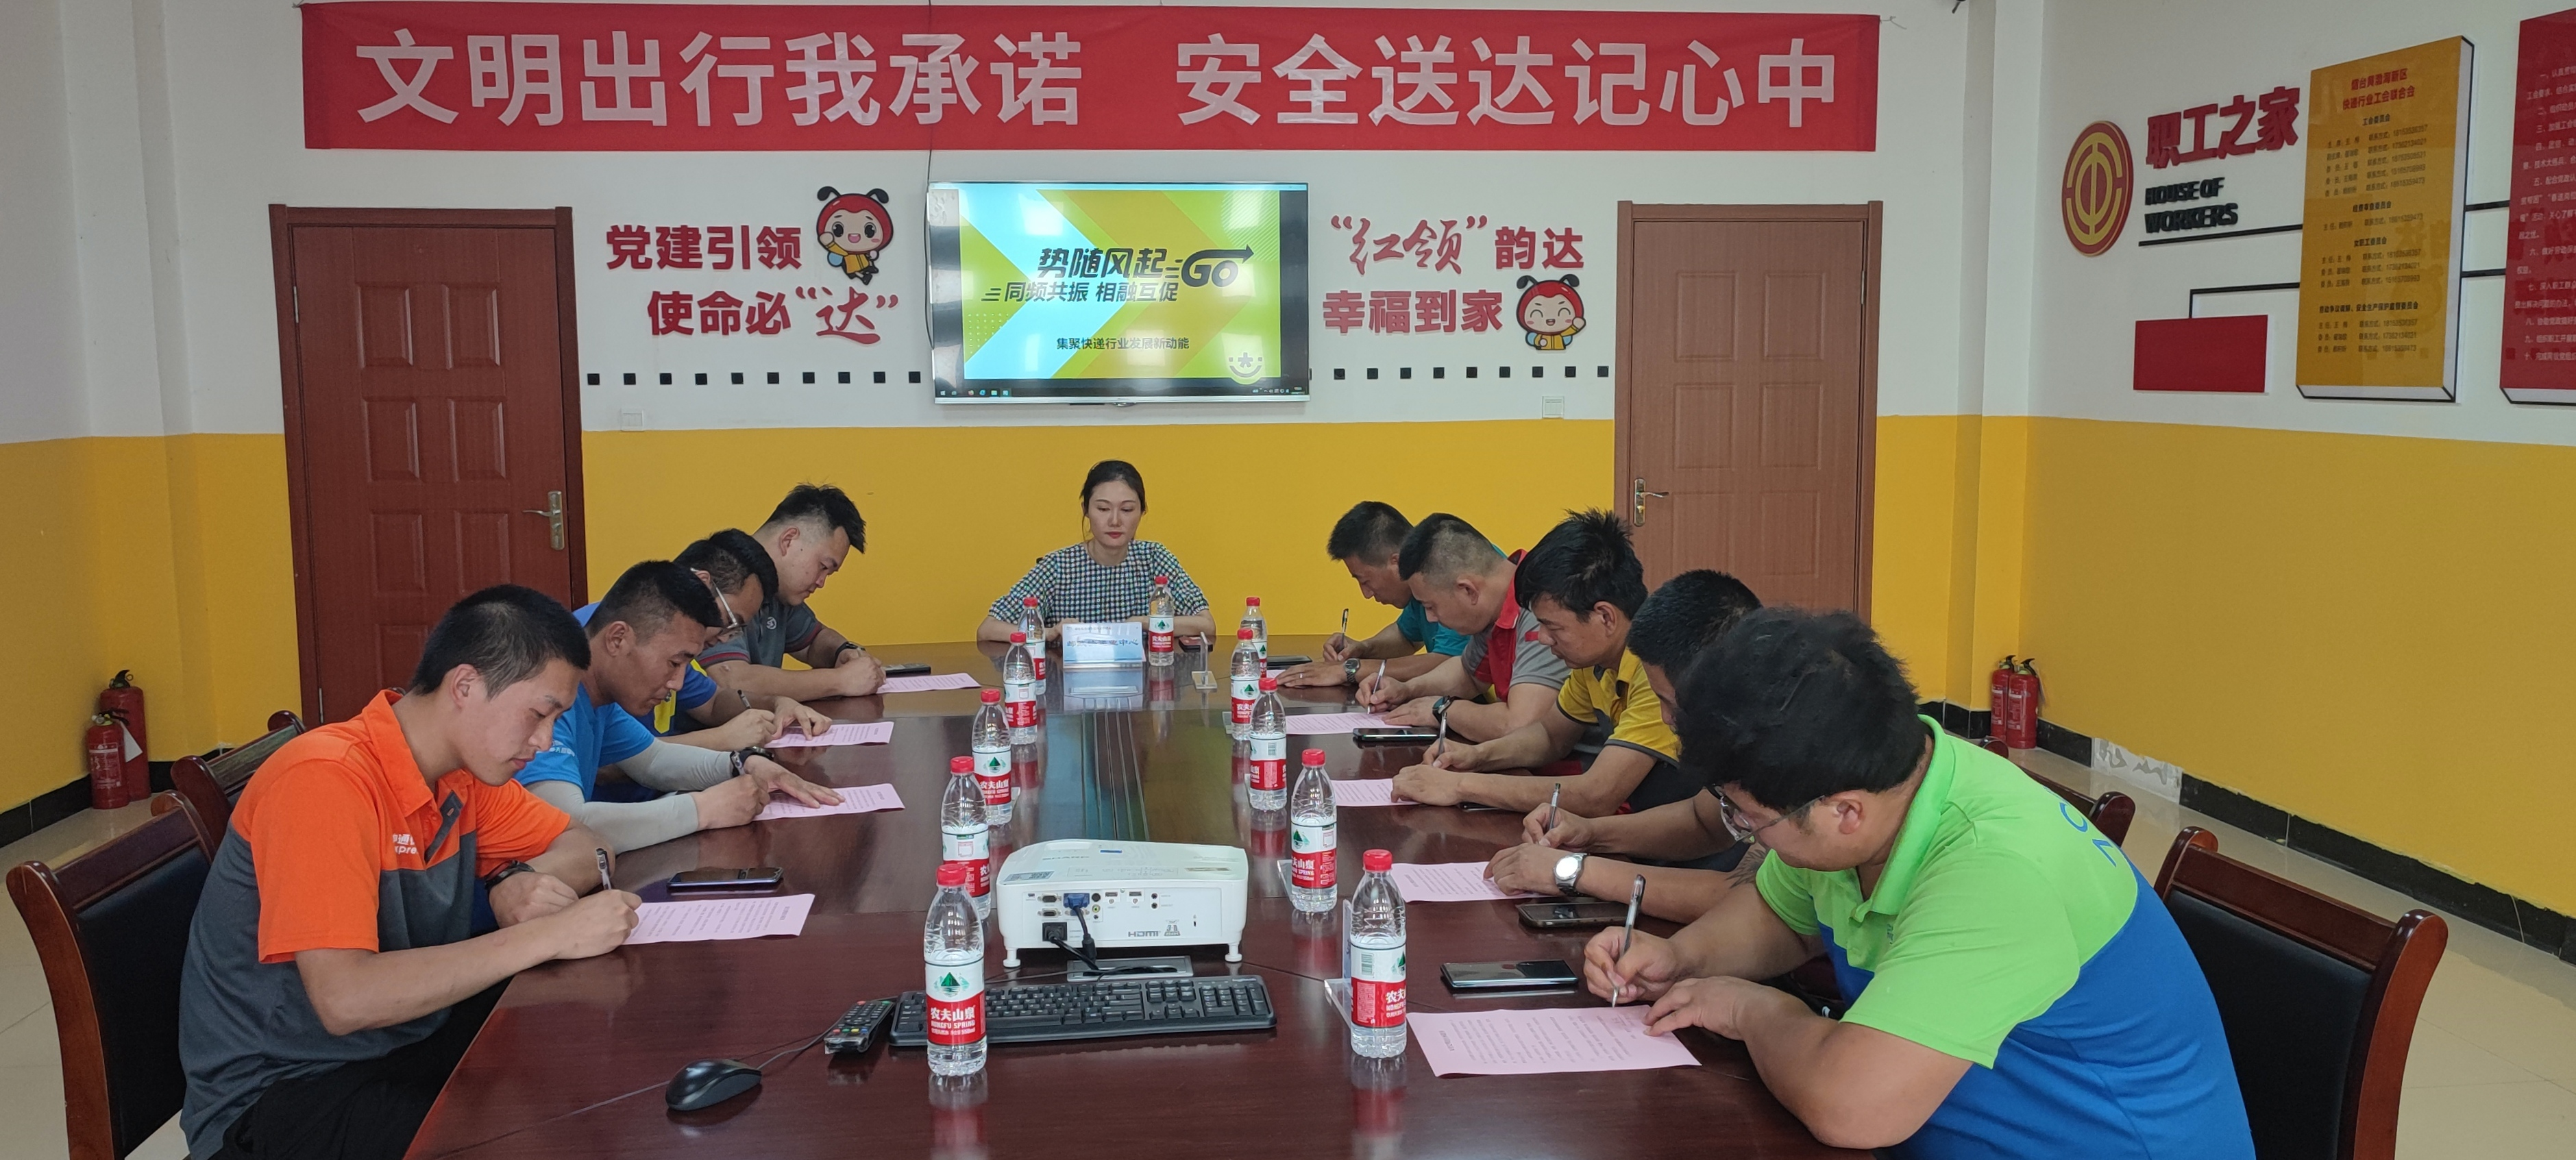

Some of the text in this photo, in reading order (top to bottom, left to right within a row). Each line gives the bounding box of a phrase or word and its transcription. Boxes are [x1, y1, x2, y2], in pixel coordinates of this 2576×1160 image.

[356, 27, 1835, 128] 文明出行我承诺 安全送达记心中
[2146, 86, 2301, 169] 职工之家
[2145, 177, 2225, 205] HOUSE OF
[2144, 203, 2239, 233] WORKERS
[606, 225, 802, 270] 党建引领
[1038, 247, 1166, 278] 势随风起
[1004, 282, 1179, 302] 同频共振 相融互促
[1323, 289, 1503, 334] 幸福到家
[1057, 338, 1190, 350] 集聚快递行业发展新动能
[931, 1006, 975, 1022] 农夫山泉
[953, 1020, 975, 1029] SPRING
